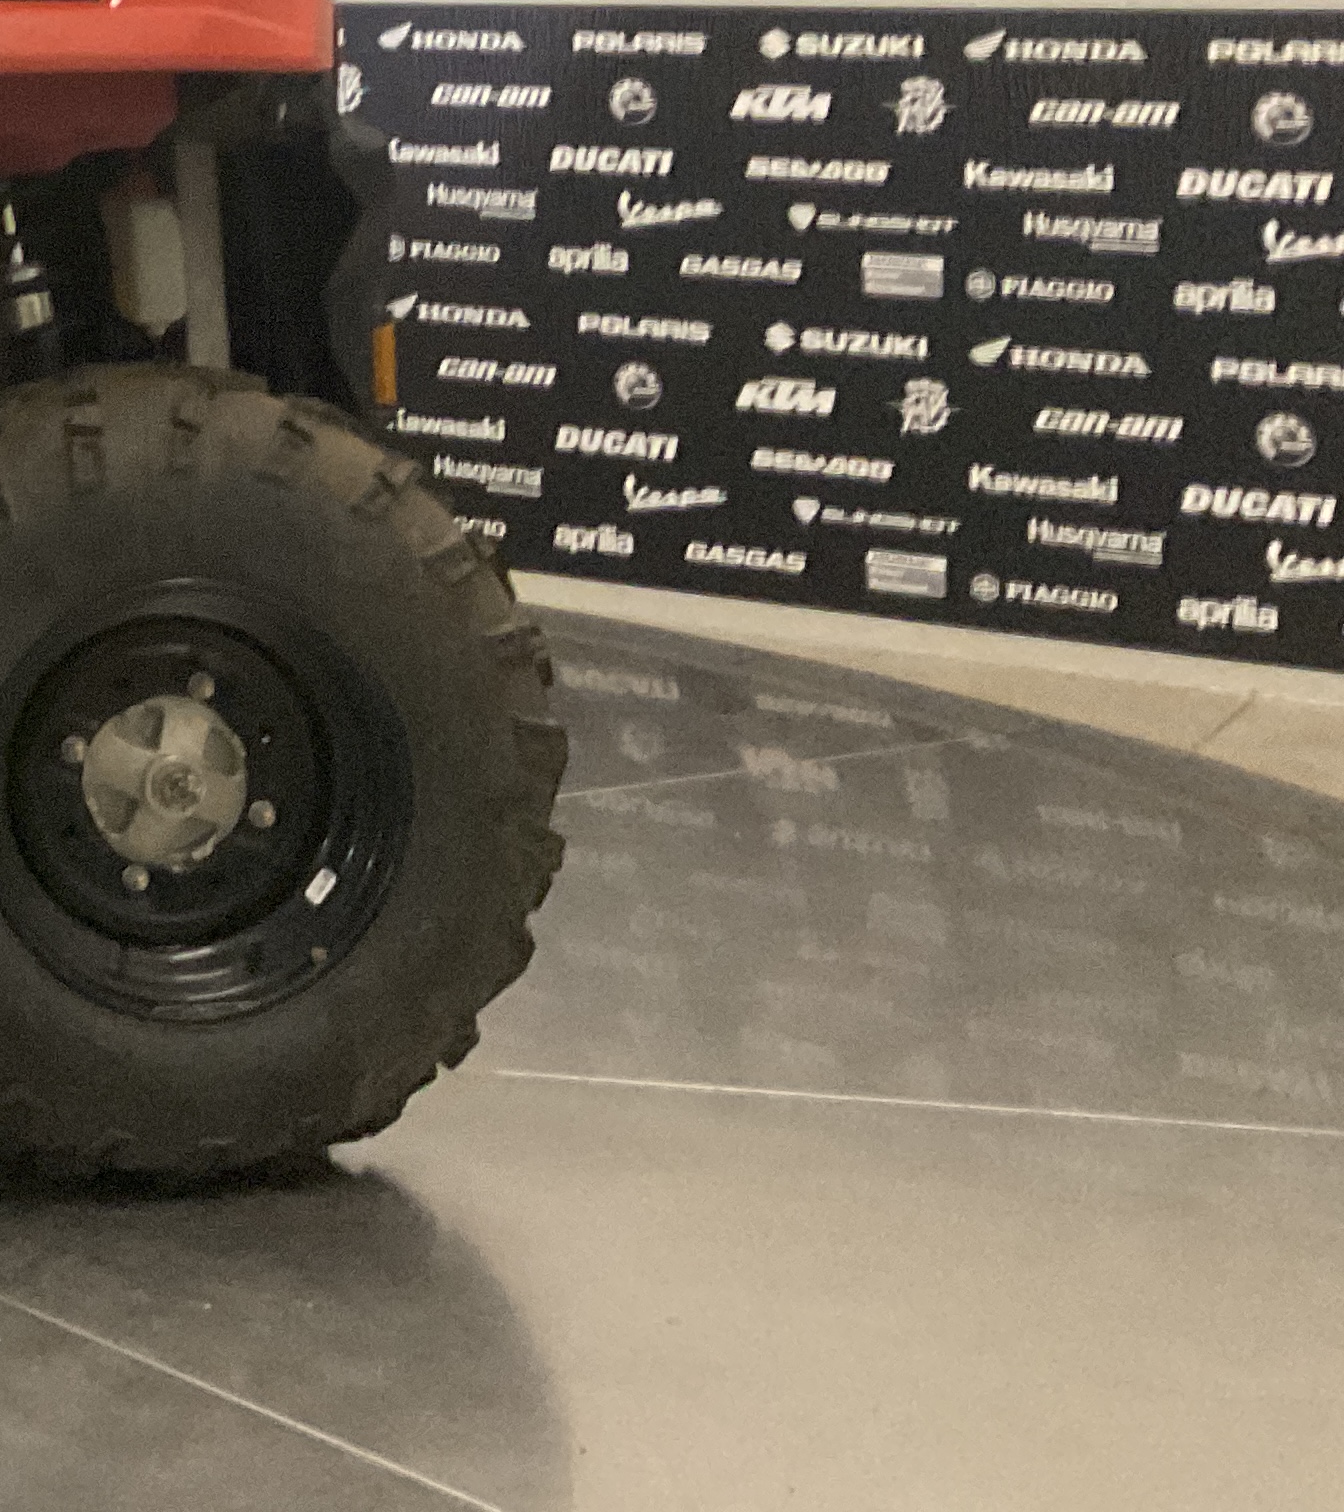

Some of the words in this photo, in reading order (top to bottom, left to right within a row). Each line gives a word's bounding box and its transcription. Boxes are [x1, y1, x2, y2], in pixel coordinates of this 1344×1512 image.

[411, 30, 525, 52] HONDA
[572, 30, 707, 55] POLARIS
[795, 33, 925, 59] SUZUKI
[729, 84, 832, 122] KTM
[549, 145, 674, 177] DUCATI
[963, 159, 1115, 193] Kawasaki
[1176, 167, 1334, 204] DUCATI
[1173, 278, 1276, 316] aprilia
[417, 302, 531, 329] HONDA
[577, 313, 712, 344] POLARIS
[800, 328, 928, 361] SUZUKI
[735, 378, 837, 416] KTM
[554, 425, 679, 462] DUCATI
[968, 463, 1119, 505] Kawasaki
[1180, 483, 1337, 528] DUCATI
[684, 541, 807, 574] GASGAS
[1176, 595, 1279, 633] aprilia
